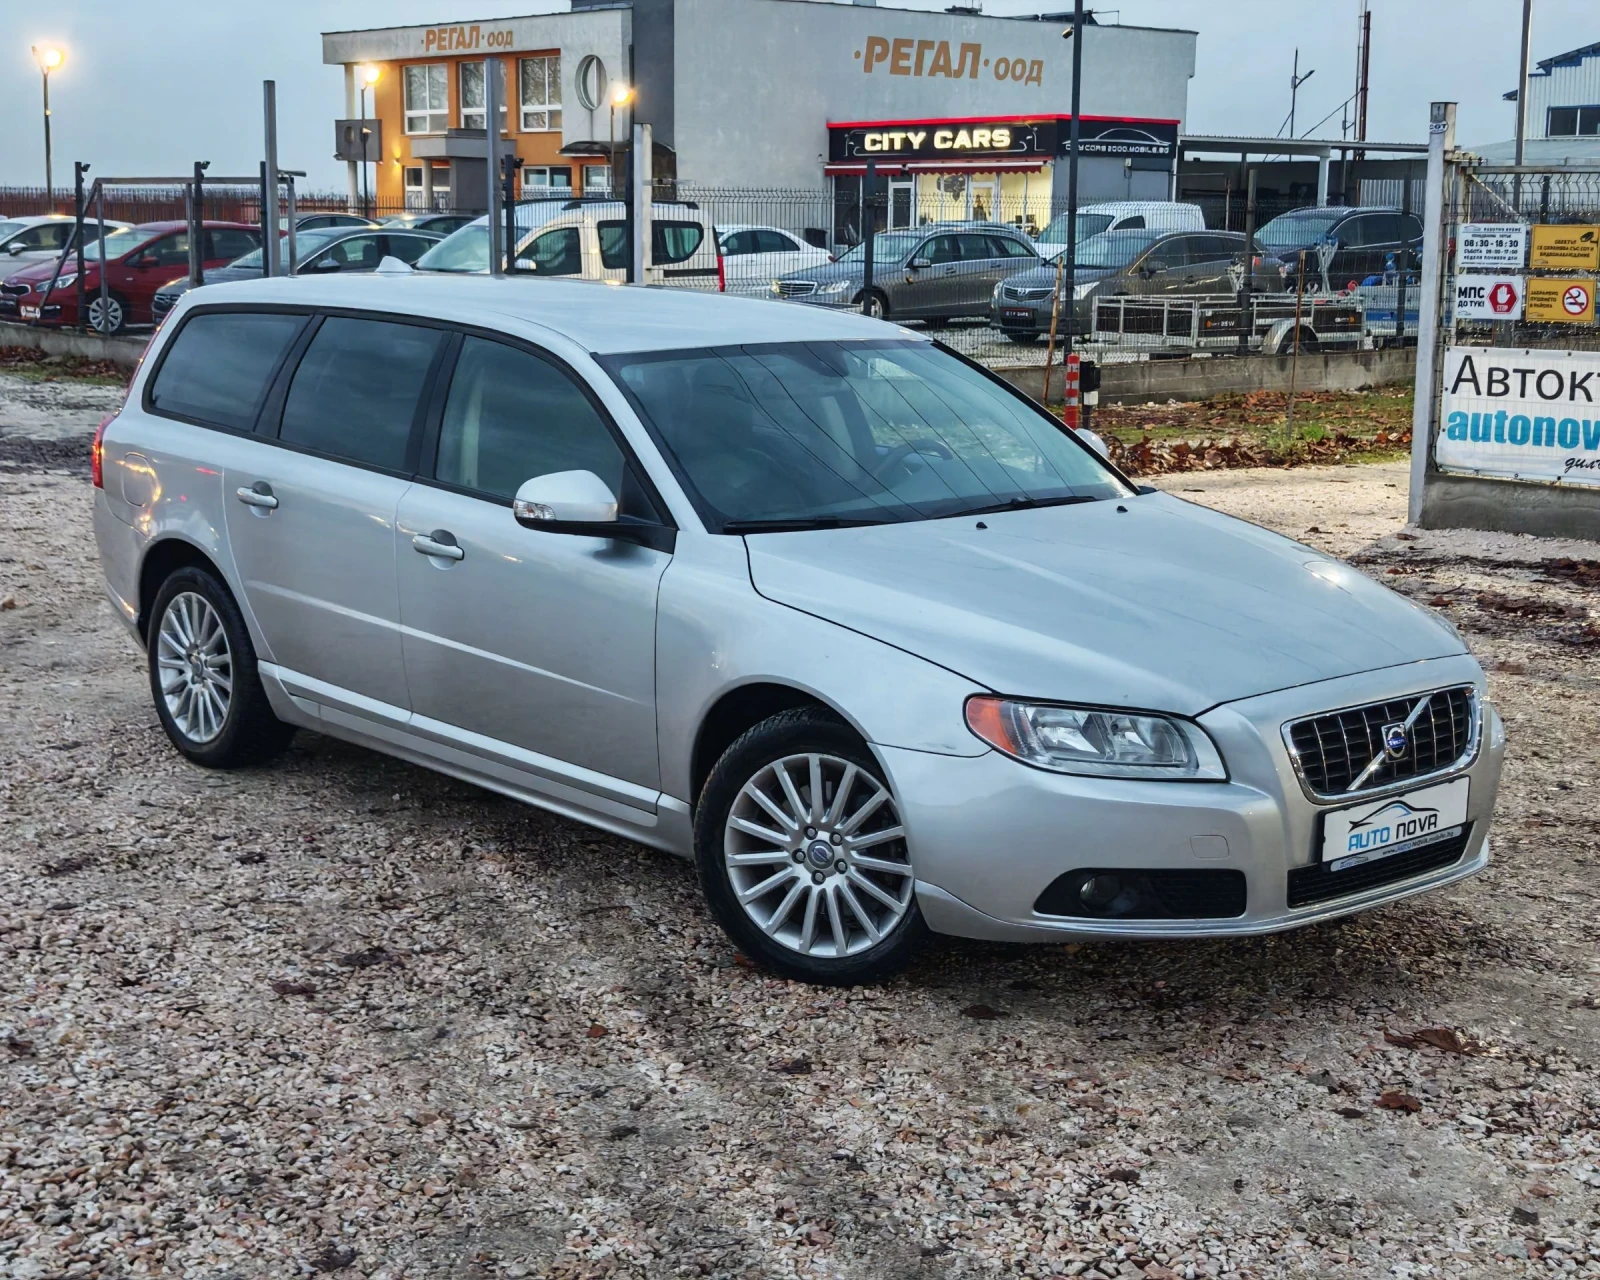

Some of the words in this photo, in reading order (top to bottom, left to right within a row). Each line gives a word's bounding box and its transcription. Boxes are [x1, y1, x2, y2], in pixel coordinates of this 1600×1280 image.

[864, 131, 926, 151] CITY
[933, 128, 1011, 150] CARS
[1065, 143, 1084, 151] CY
[1457, 286, 1485, 299] МПС
[1457, 300, 1468, 308] ДО
[1348, 826, 1390, 851] AUTO
[1395, 813, 1438, 840] NOVA
